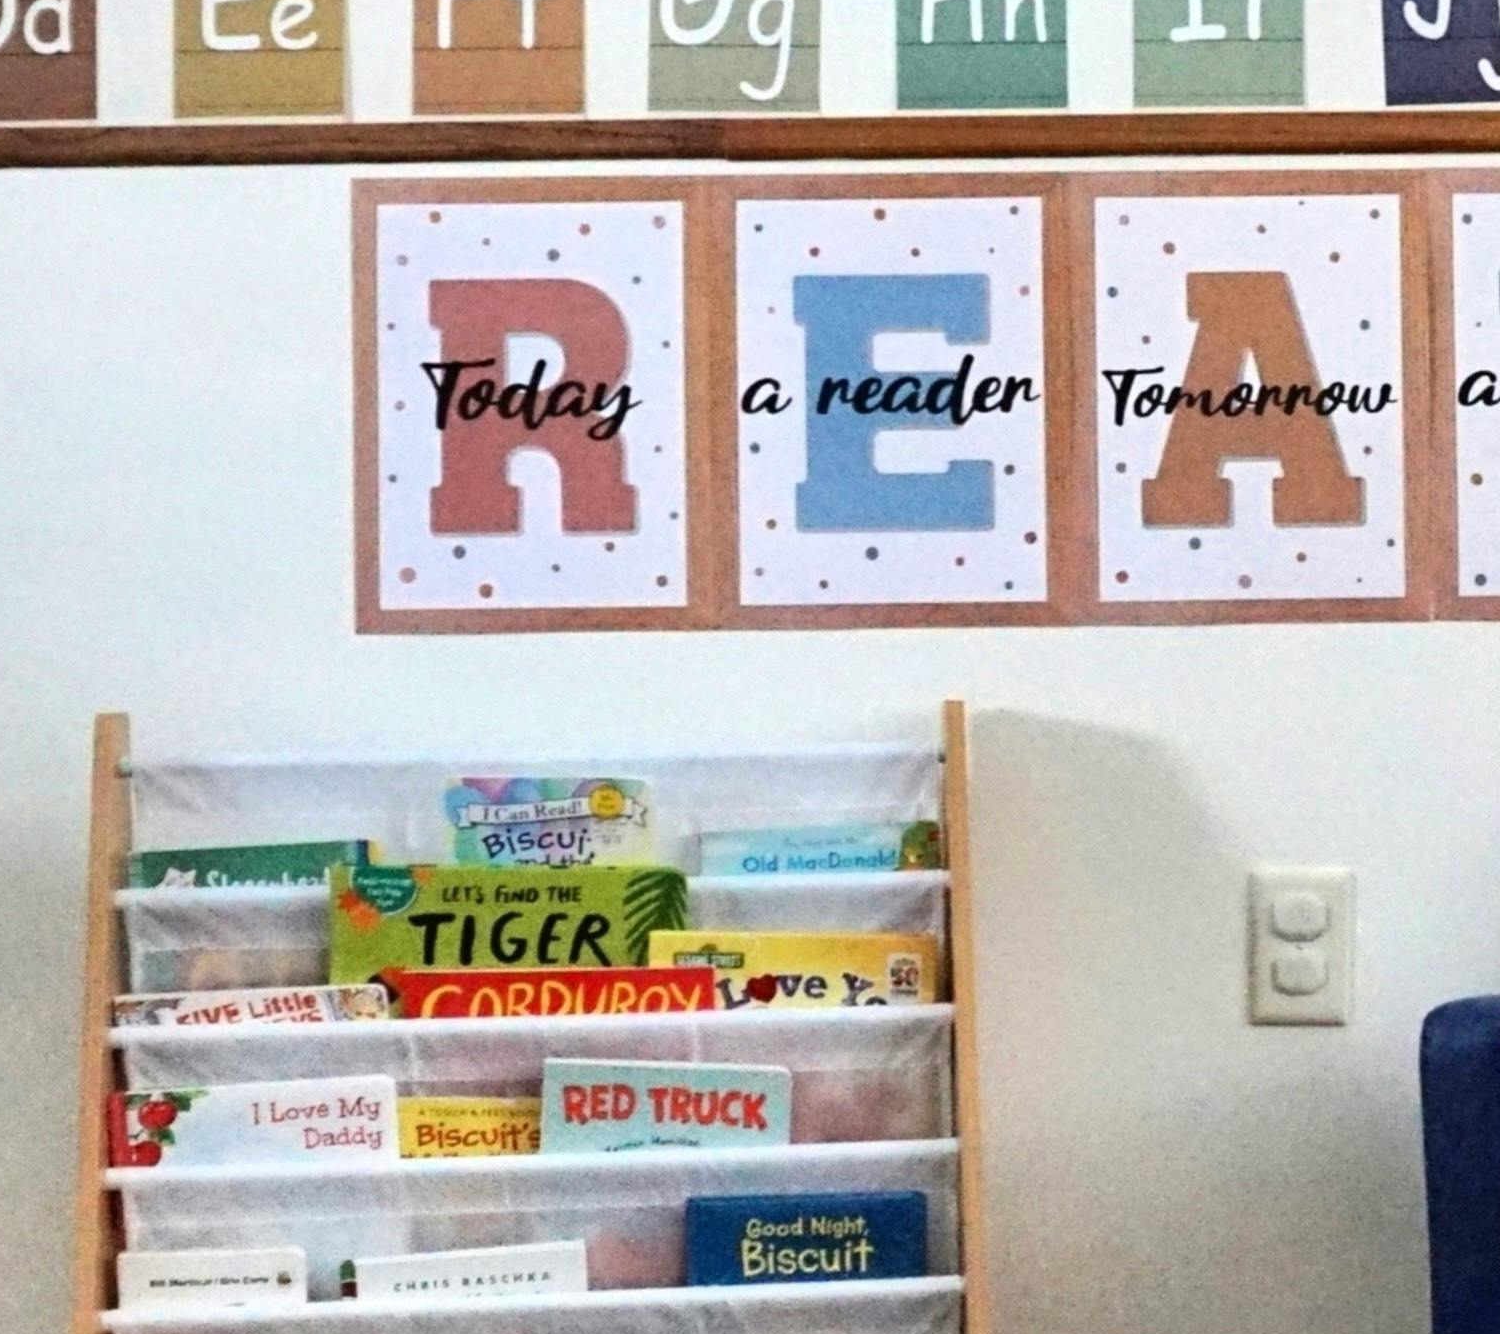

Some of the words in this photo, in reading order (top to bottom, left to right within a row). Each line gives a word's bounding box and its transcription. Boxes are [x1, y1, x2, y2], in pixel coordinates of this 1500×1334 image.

[420, 358, 642, 440] Today
[741, 376, 792, 415] a
[816, 354, 1040, 426] reader
[1101, 367, 1397, 426] Tomorrow
[495, 806, 529, 821] Can
[534, 798, 582, 819] Read!
[482, 827, 593, 859] Biscui
[742, 854, 778, 873] Old
[788, 848, 897, 872] MacDonald
[442, 885, 484, 904] LET'S
[547, 885, 582, 904] THE
[408, 912, 612, 967] TIGER
[248, 992, 317, 1019] Little
[252, 1102, 260, 1125] I
[270, 1099, 330, 1123] Love
[337, 1096, 382, 1121] My
[563, 1083, 637, 1126] RED
[647, 1085, 768, 1131] TRUCK
[303, 1126, 384, 1150] Daddy
[416, 1122, 541, 1151] Biscuit's
[746, 1217, 804, 1239] Good
[810, 1216, 870, 1240] Night,
[741, 1238, 875, 1278] Biscuit
[393, 1278, 450, 1293] CHRIS
